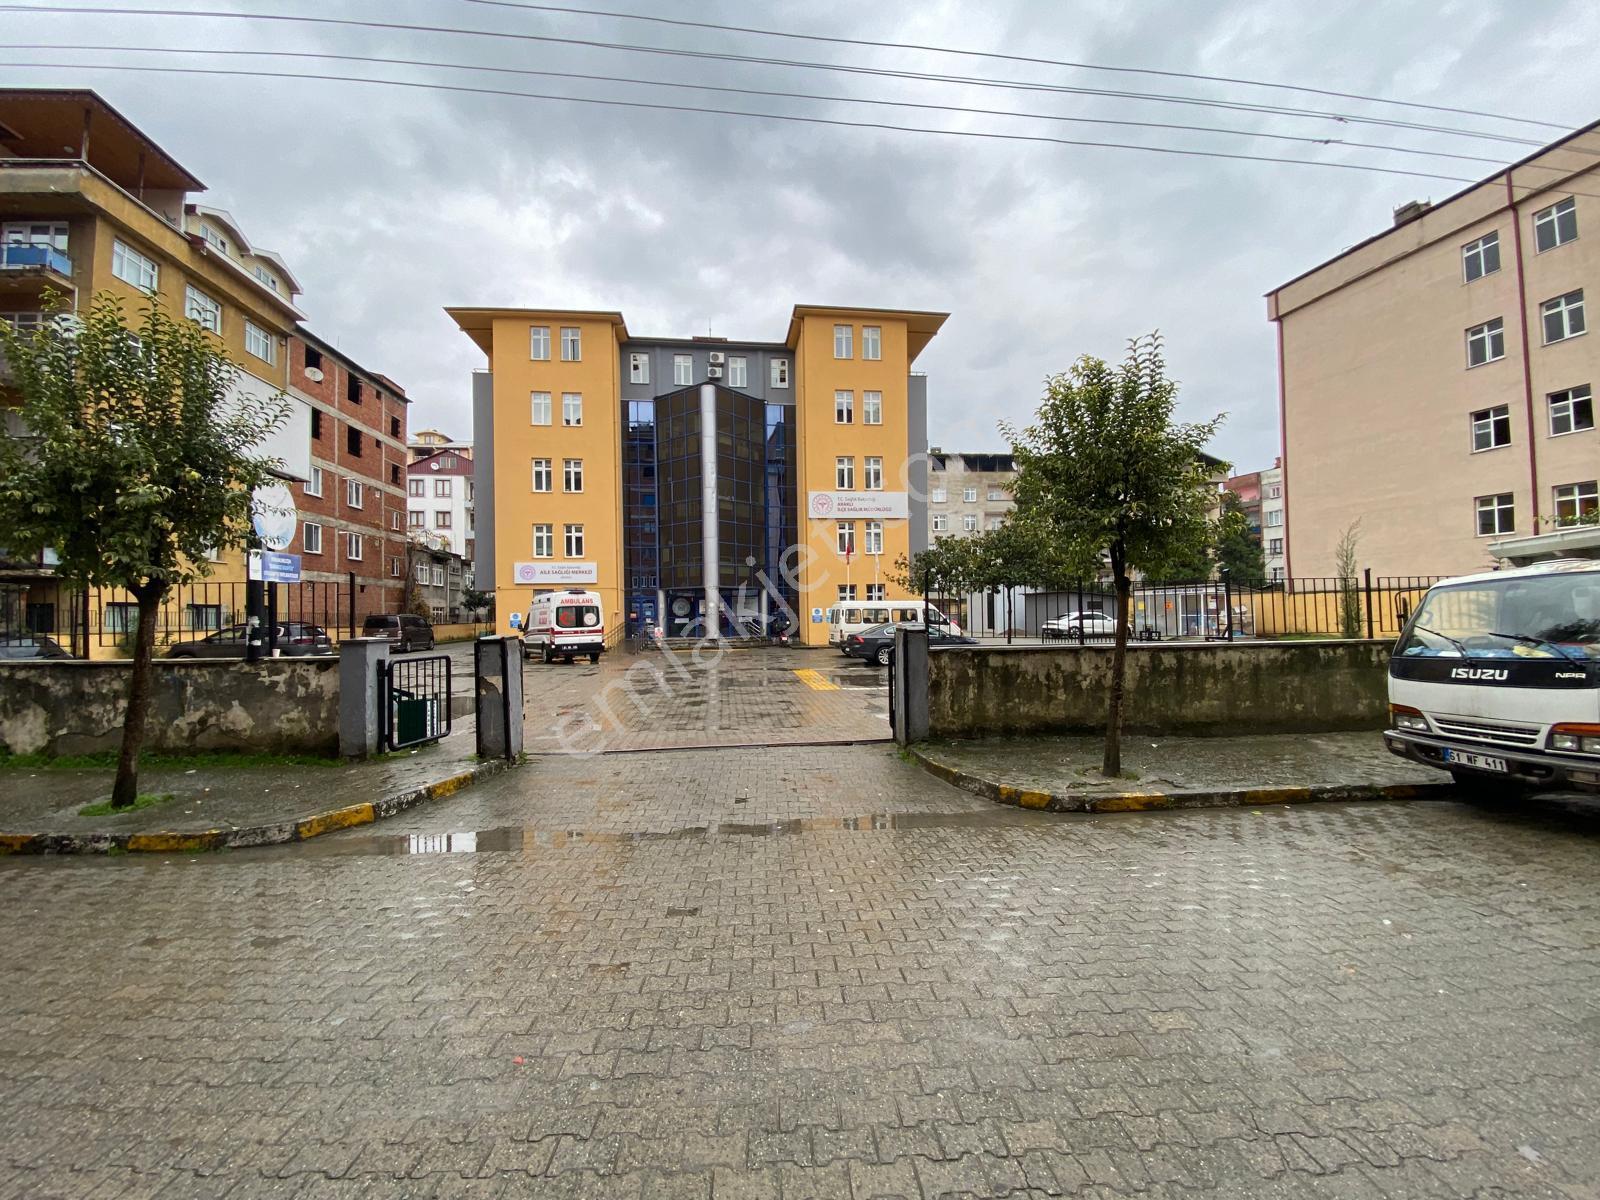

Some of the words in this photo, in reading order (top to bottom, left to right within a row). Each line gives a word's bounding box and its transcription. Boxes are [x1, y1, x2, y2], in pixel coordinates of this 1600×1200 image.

[1451, 668, 1509, 680] ISUZU
[1449, 751, 1461, 763] 61
[1484, 758, 1505, 771] 411
